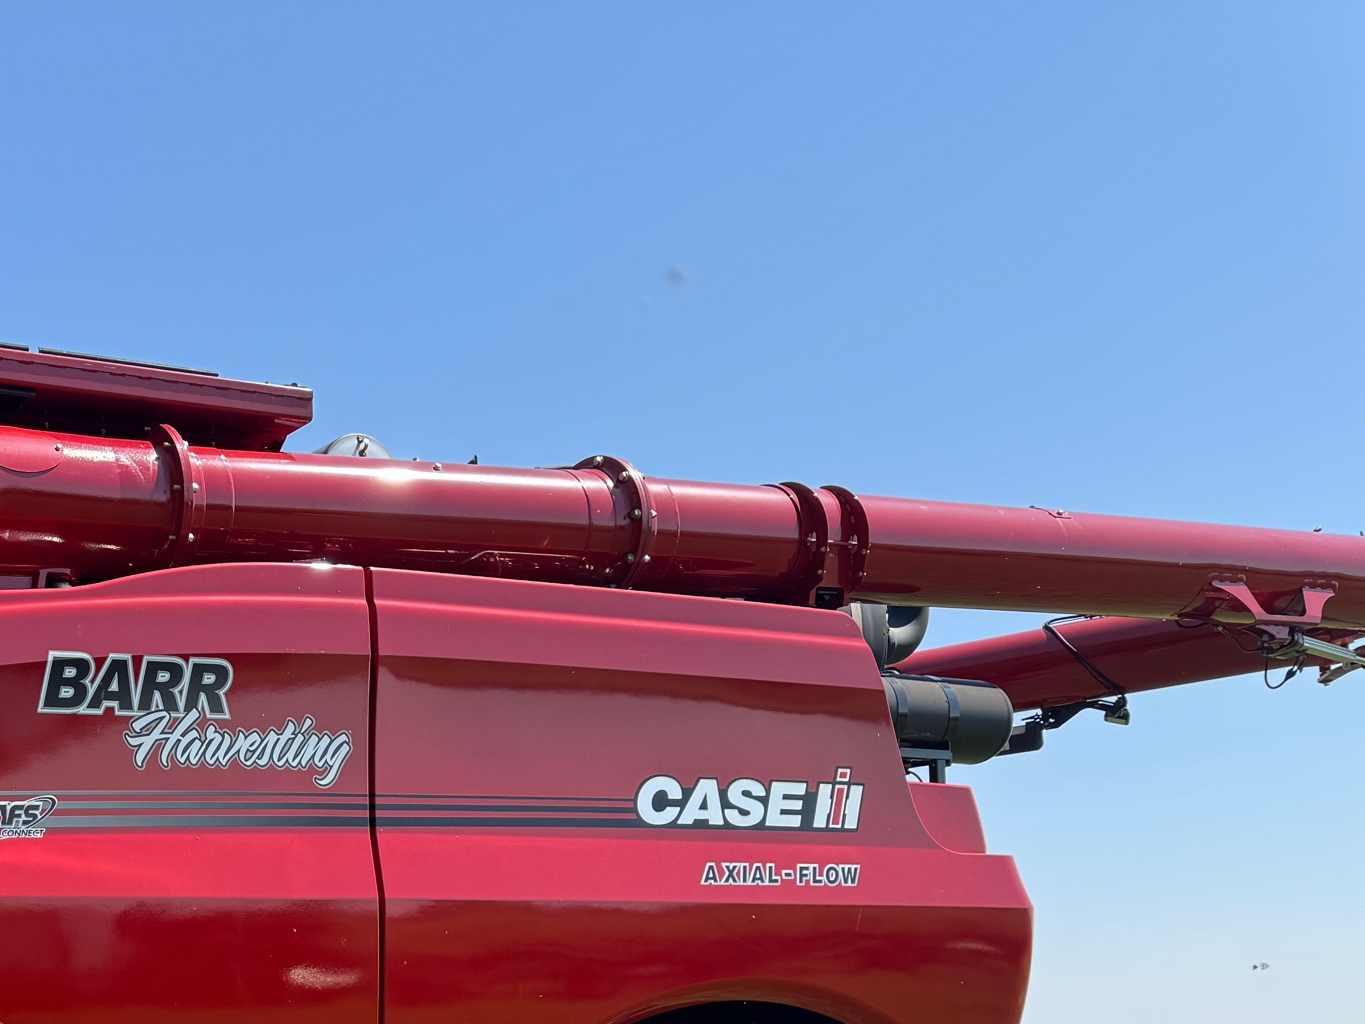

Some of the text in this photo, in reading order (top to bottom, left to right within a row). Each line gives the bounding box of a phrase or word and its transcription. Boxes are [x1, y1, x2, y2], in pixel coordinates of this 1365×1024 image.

[38, 650, 233, 719] BARR
[124, 707, 352, 788] Harvesting
[636, 775, 807, 827] CASE
[1, 828, 45, 838] CONNECT
[701, 862, 860, 886] AXIAL-FLOW
